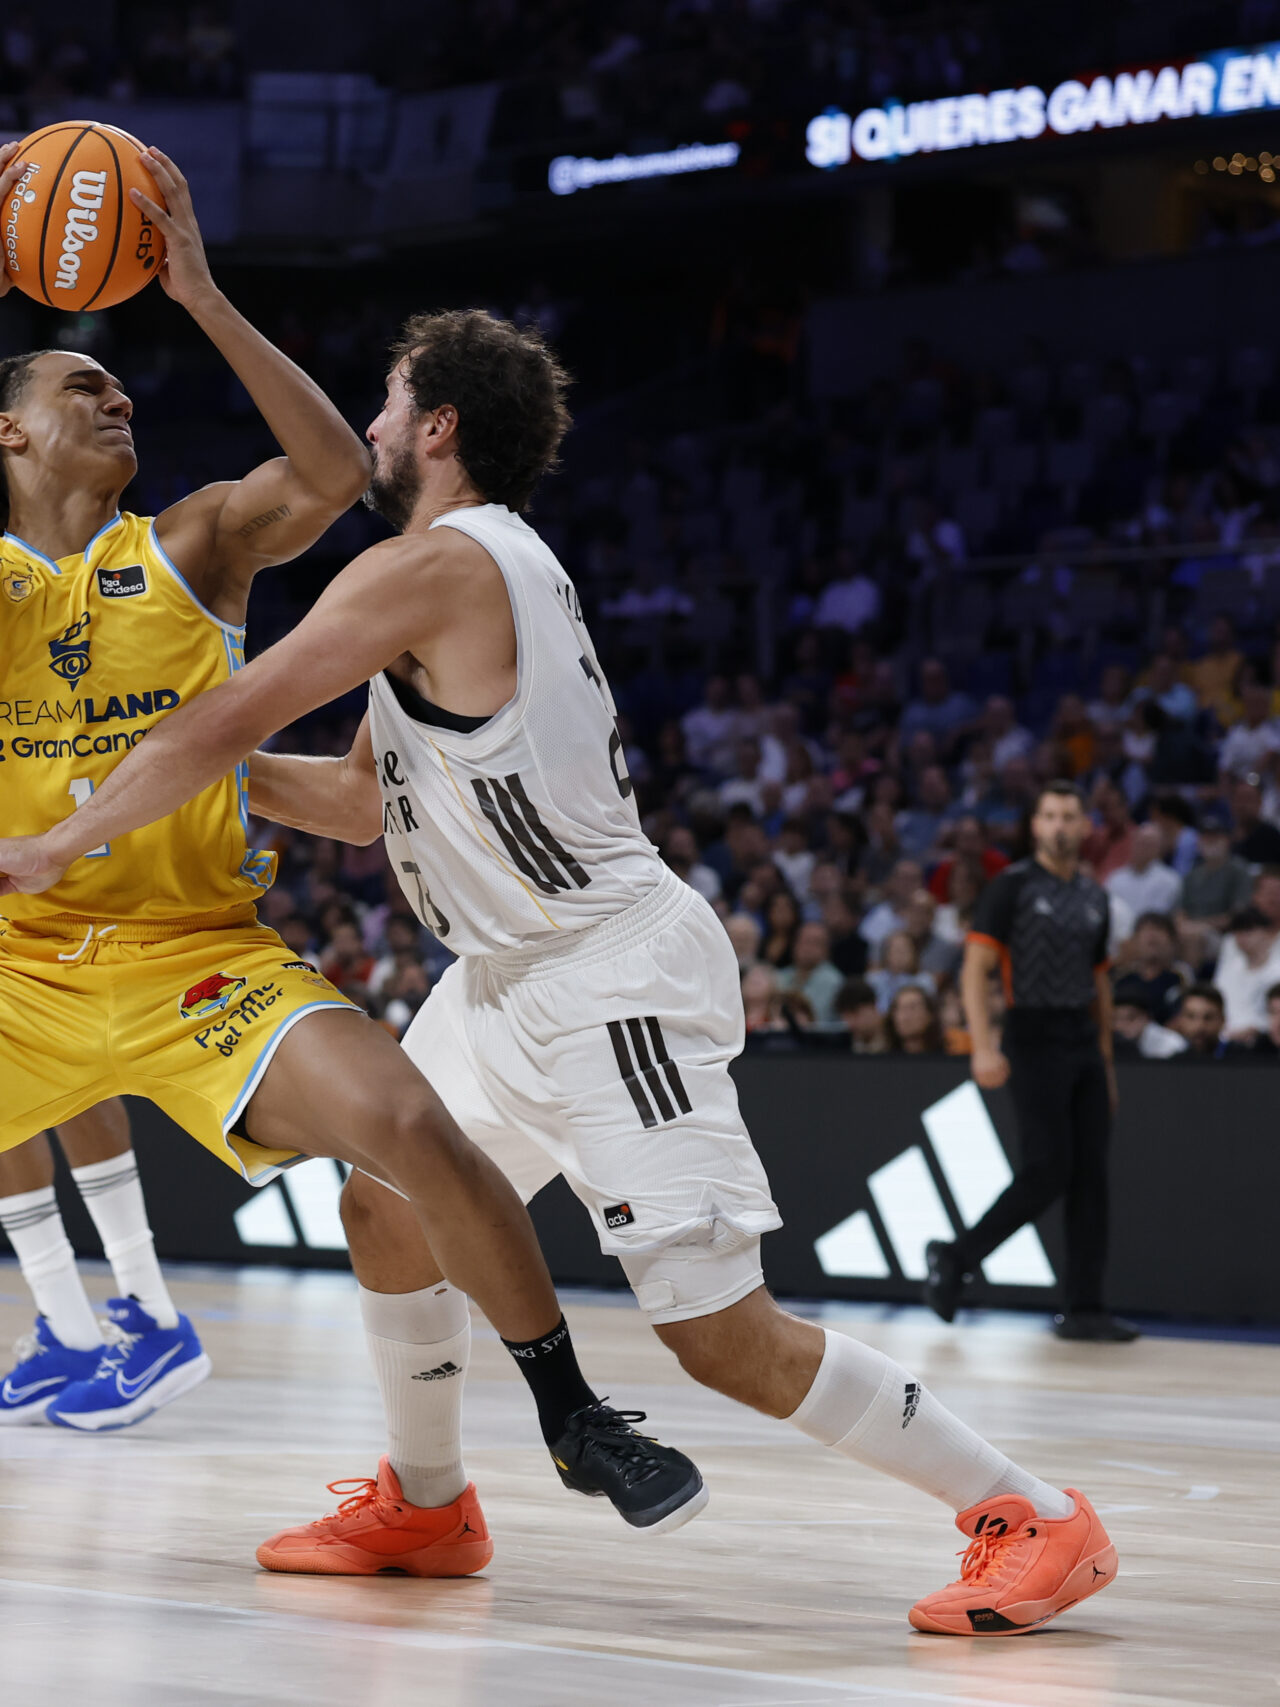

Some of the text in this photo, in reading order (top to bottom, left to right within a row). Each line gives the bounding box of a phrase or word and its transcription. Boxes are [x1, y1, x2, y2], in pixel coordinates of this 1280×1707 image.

[805, 110, 851, 168] SI
[852, 85, 1047, 161] QUIERES
[1047, 61, 1217, 135] GANAR
[6, 162, 41, 272] liga endesa
[54, 170, 108, 290] Wilson
[102, 577, 120, 588] liga
[103, 583, 143, 594] endesa
[11, 728, 152, 759] GranCana
[215, 1026, 242, 1057] del
[608, 1214, 627, 1226] acb
